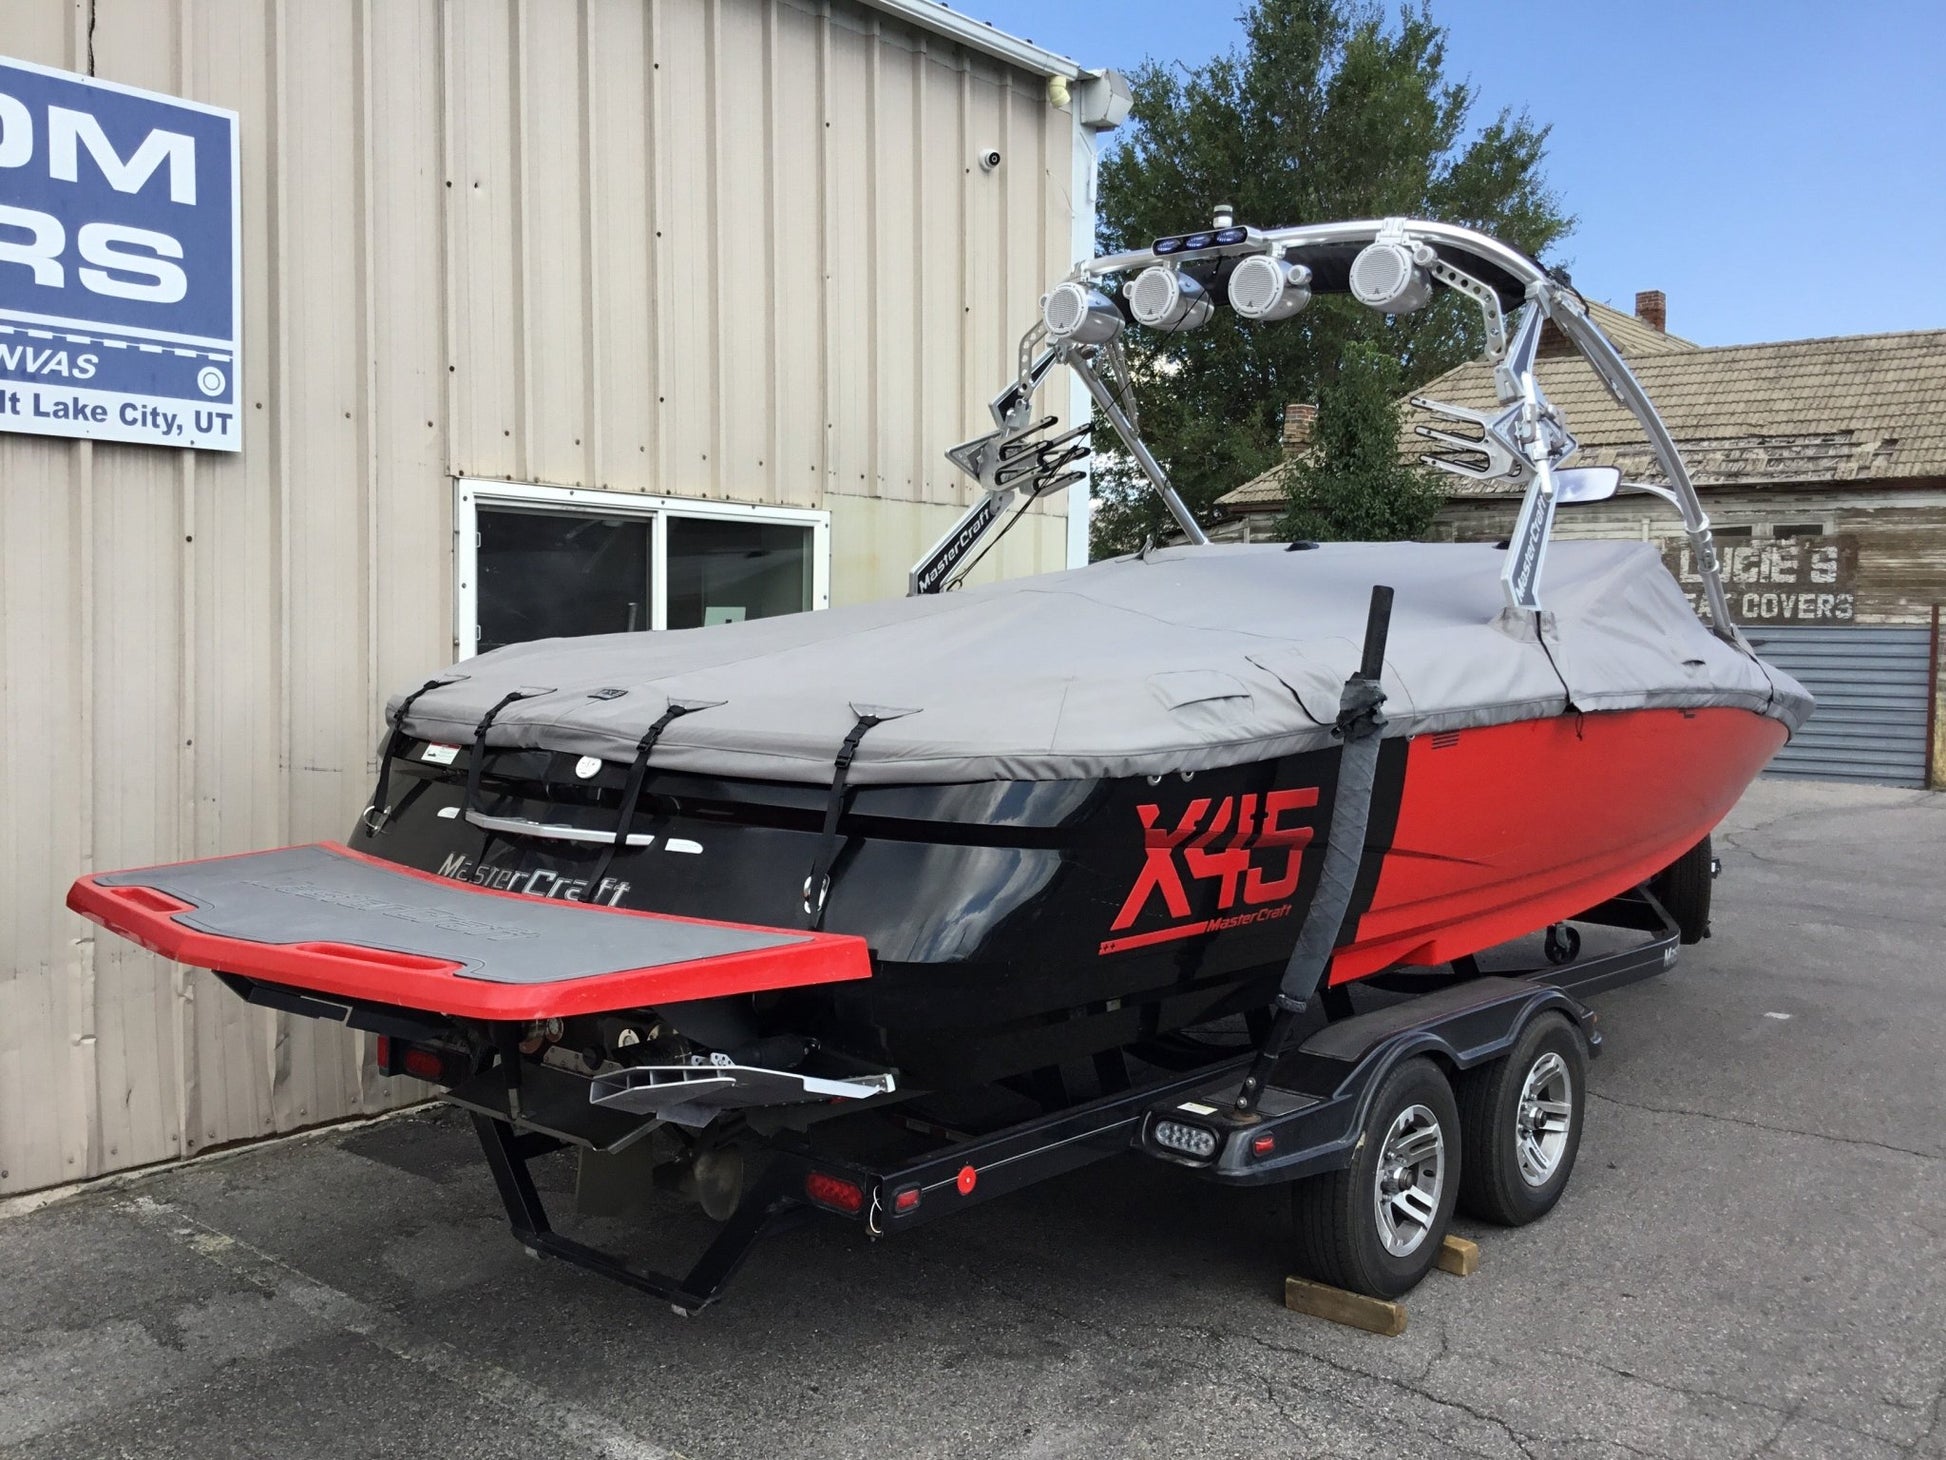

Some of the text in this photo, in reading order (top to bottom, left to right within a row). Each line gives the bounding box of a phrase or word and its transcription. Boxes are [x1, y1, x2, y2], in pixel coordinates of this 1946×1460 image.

[33, 392, 108, 423] Lake
[119, 402, 183, 436] City,
[194, 410, 233, 436] UT
[918, 508, 991, 594] MasterCraft
[1515, 494, 1547, 603] MasterCraft
[1741, 593, 1853, 619] COVERS
[1109, 786, 1320, 932] X45
[1206, 904, 1293, 932] MasterCraft
